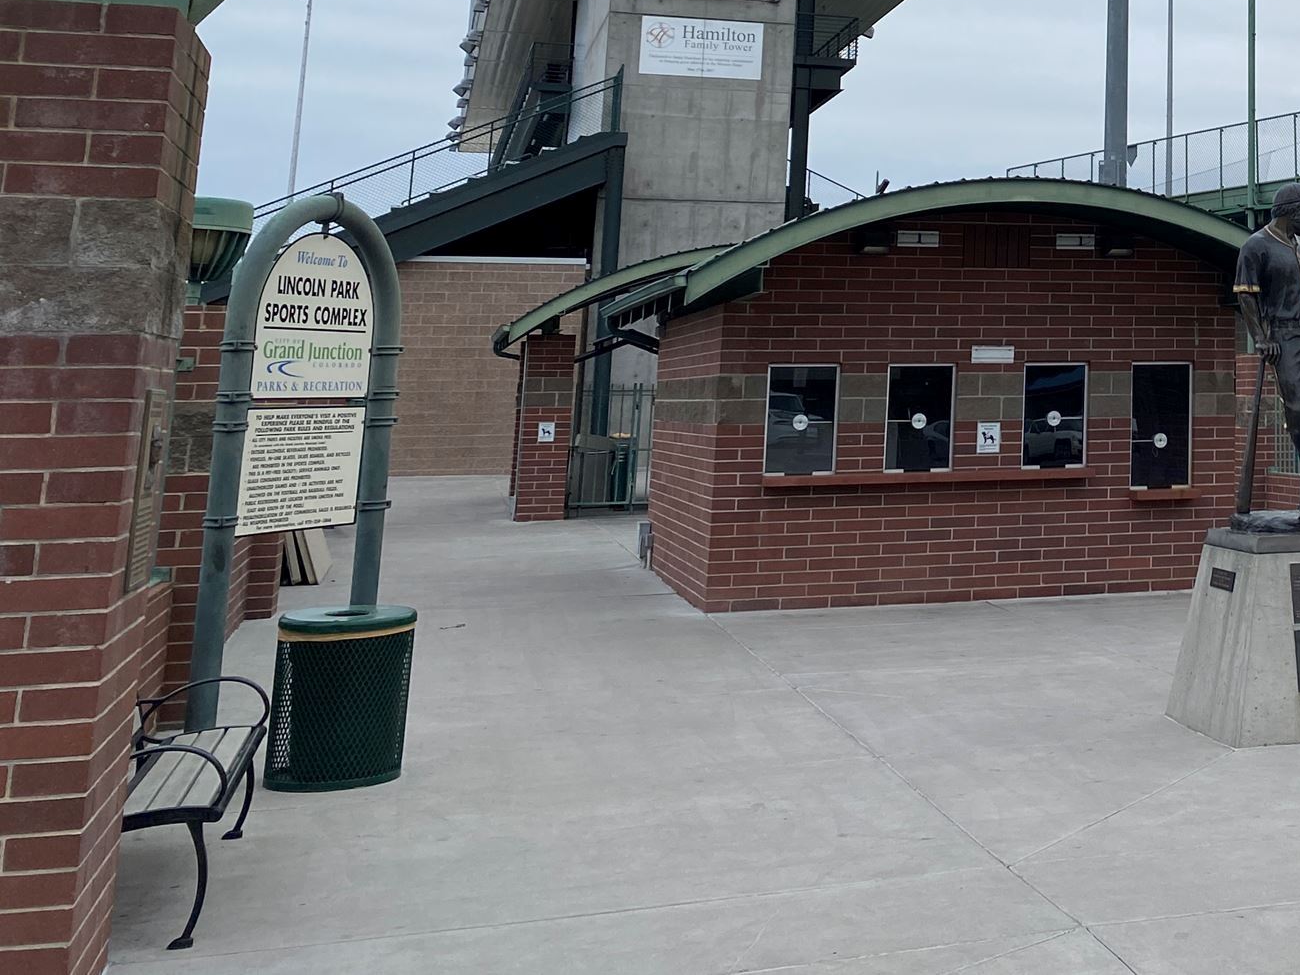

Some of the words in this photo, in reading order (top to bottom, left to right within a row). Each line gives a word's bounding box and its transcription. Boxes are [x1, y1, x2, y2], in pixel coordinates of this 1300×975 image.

[682, 25, 756, 43] Hamilton
[684, 39, 719, 55] Family
[722, 41, 753, 52] Tower
[297, 250, 335, 267] Welcome
[338, 254, 348, 268] To
[277, 275, 326, 297] LINCOLN
[330, 279, 360, 300] PARK
[264, 302, 309, 324] SPORTS
[314, 305, 367, 327] COMPLEX
[263, 339, 305, 359] Grand
[308, 342, 362, 362] Junction
[257, 381, 287, 392] PARKS
[291, 381, 298, 391] &
[303, 381, 363, 392] RECREATION
